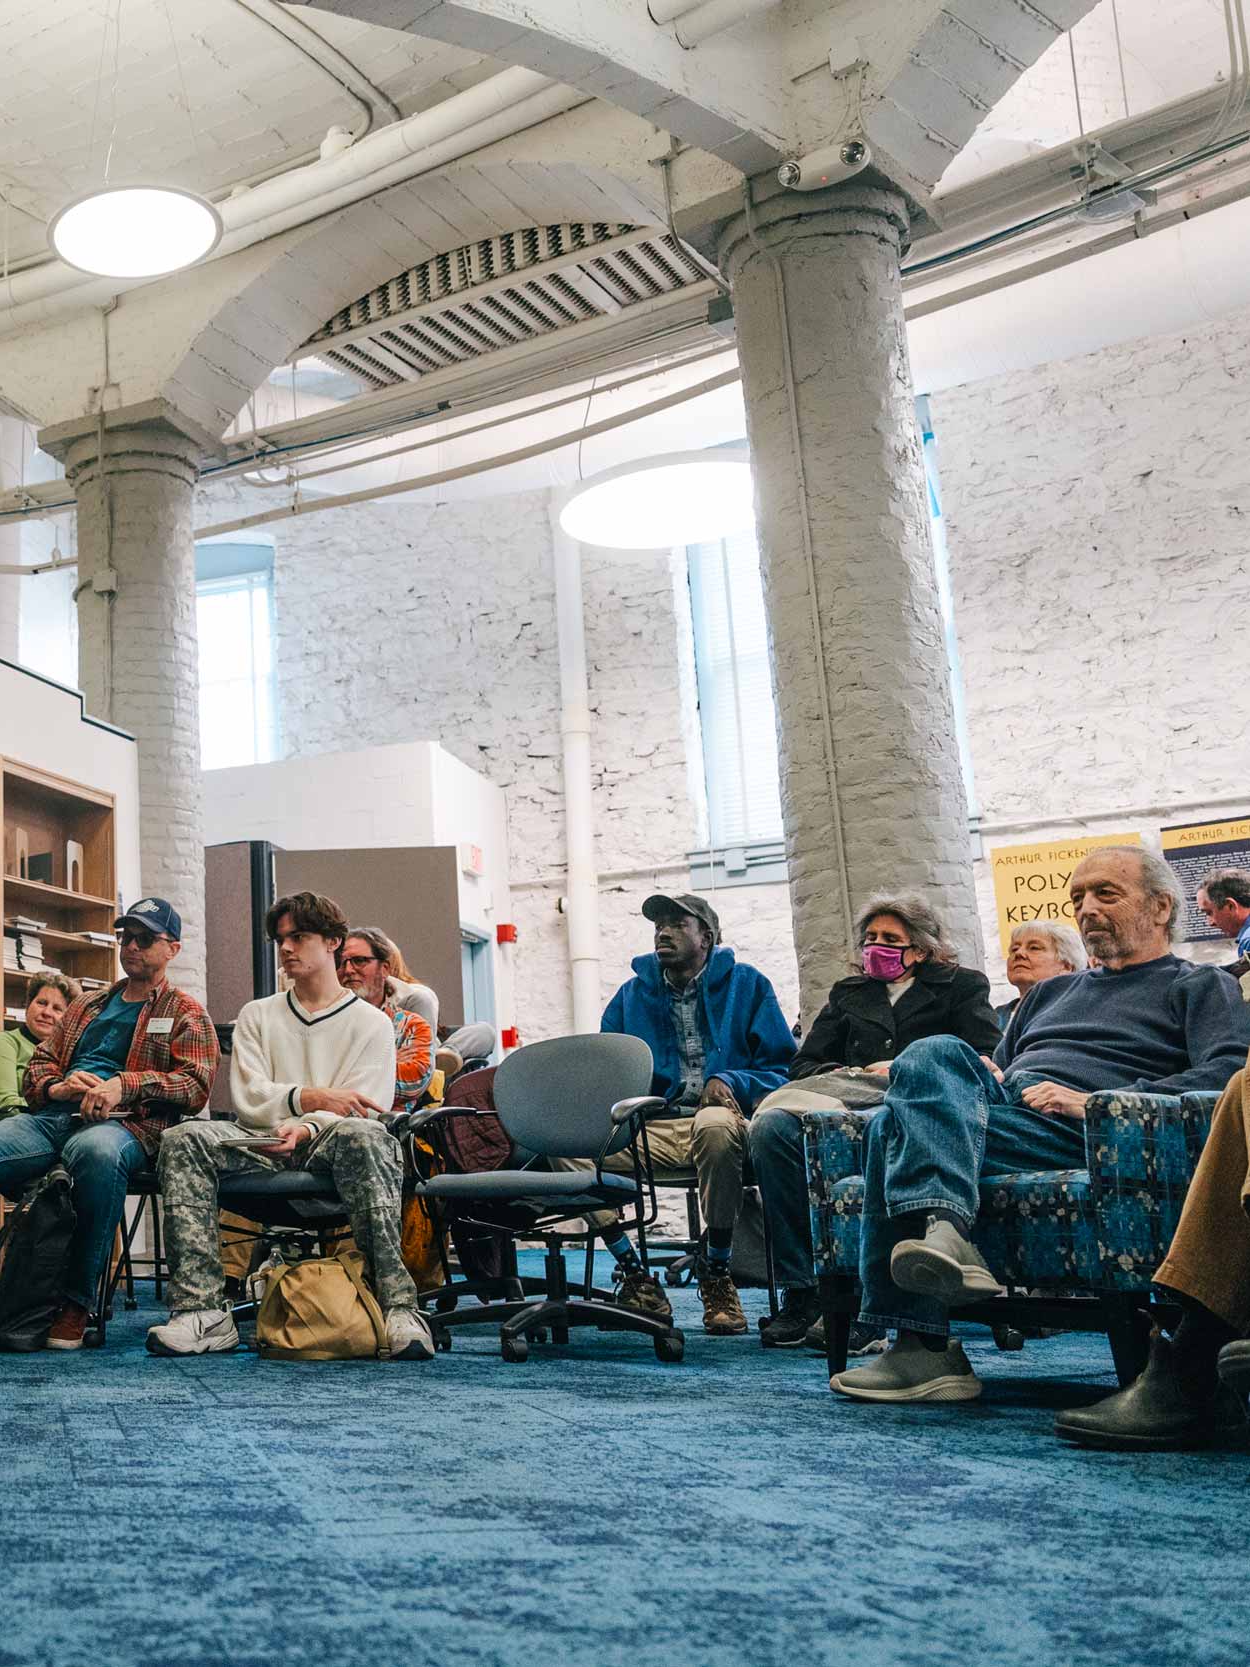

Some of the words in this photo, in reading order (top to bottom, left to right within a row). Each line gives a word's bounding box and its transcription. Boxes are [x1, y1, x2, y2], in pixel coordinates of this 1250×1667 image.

[1179, 828, 1224, 843] ARTHUR
[995, 852, 1043, 867] ARTHUR
[1014, 871, 1072, 893] POLY
